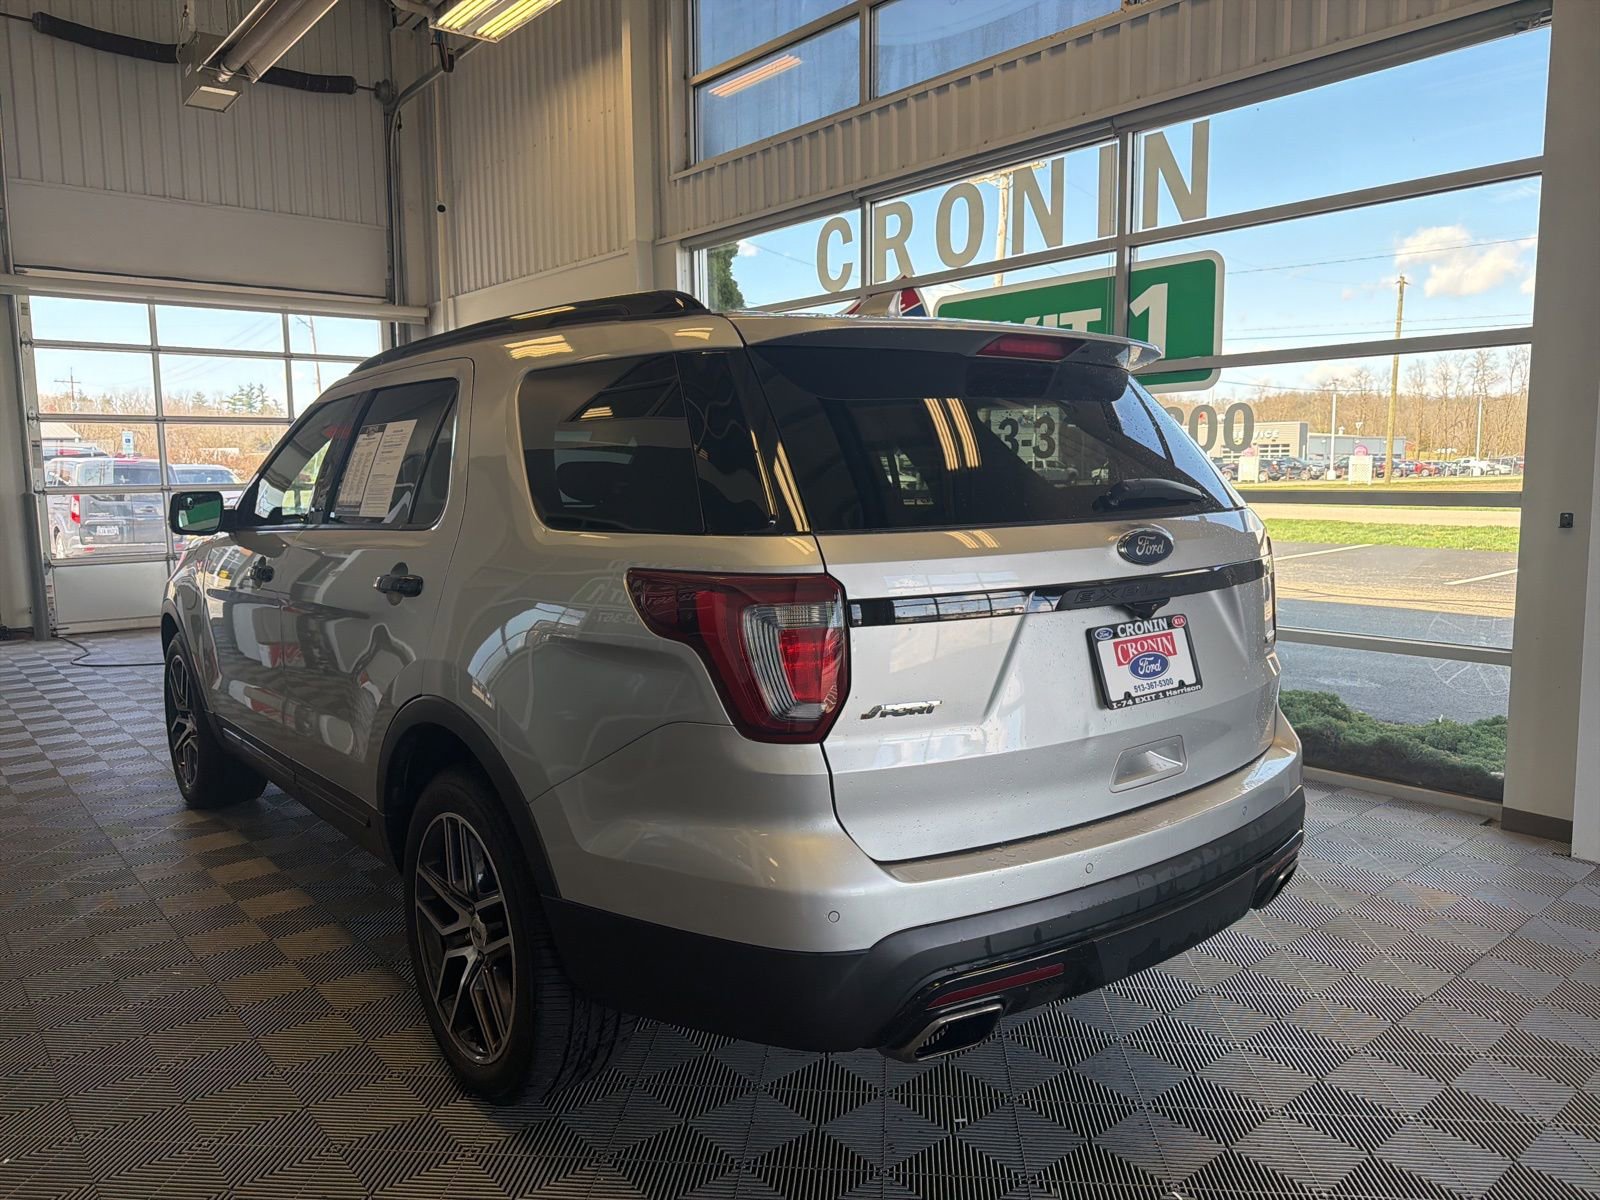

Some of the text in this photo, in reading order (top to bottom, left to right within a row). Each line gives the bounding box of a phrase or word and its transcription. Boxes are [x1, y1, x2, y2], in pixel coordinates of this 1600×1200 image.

[816, 118, 1210, 293] CRONIN
[1129, 282, 1168, 359] 1
[1135, 535, 1165, 556] Ford
[1117, 618, 1168, 637] CRONIN
[1117, 635, 1174, 664] CRONIN
[1138, 656, 1162, 675] Ford
[1112, 699, 1134, 709] I-74
[1136, 694, 1156, 704] EXIT
[1166, 684, 1201, 696] Harrison
[1133, 678, 1174, 693] 513-367-5300
